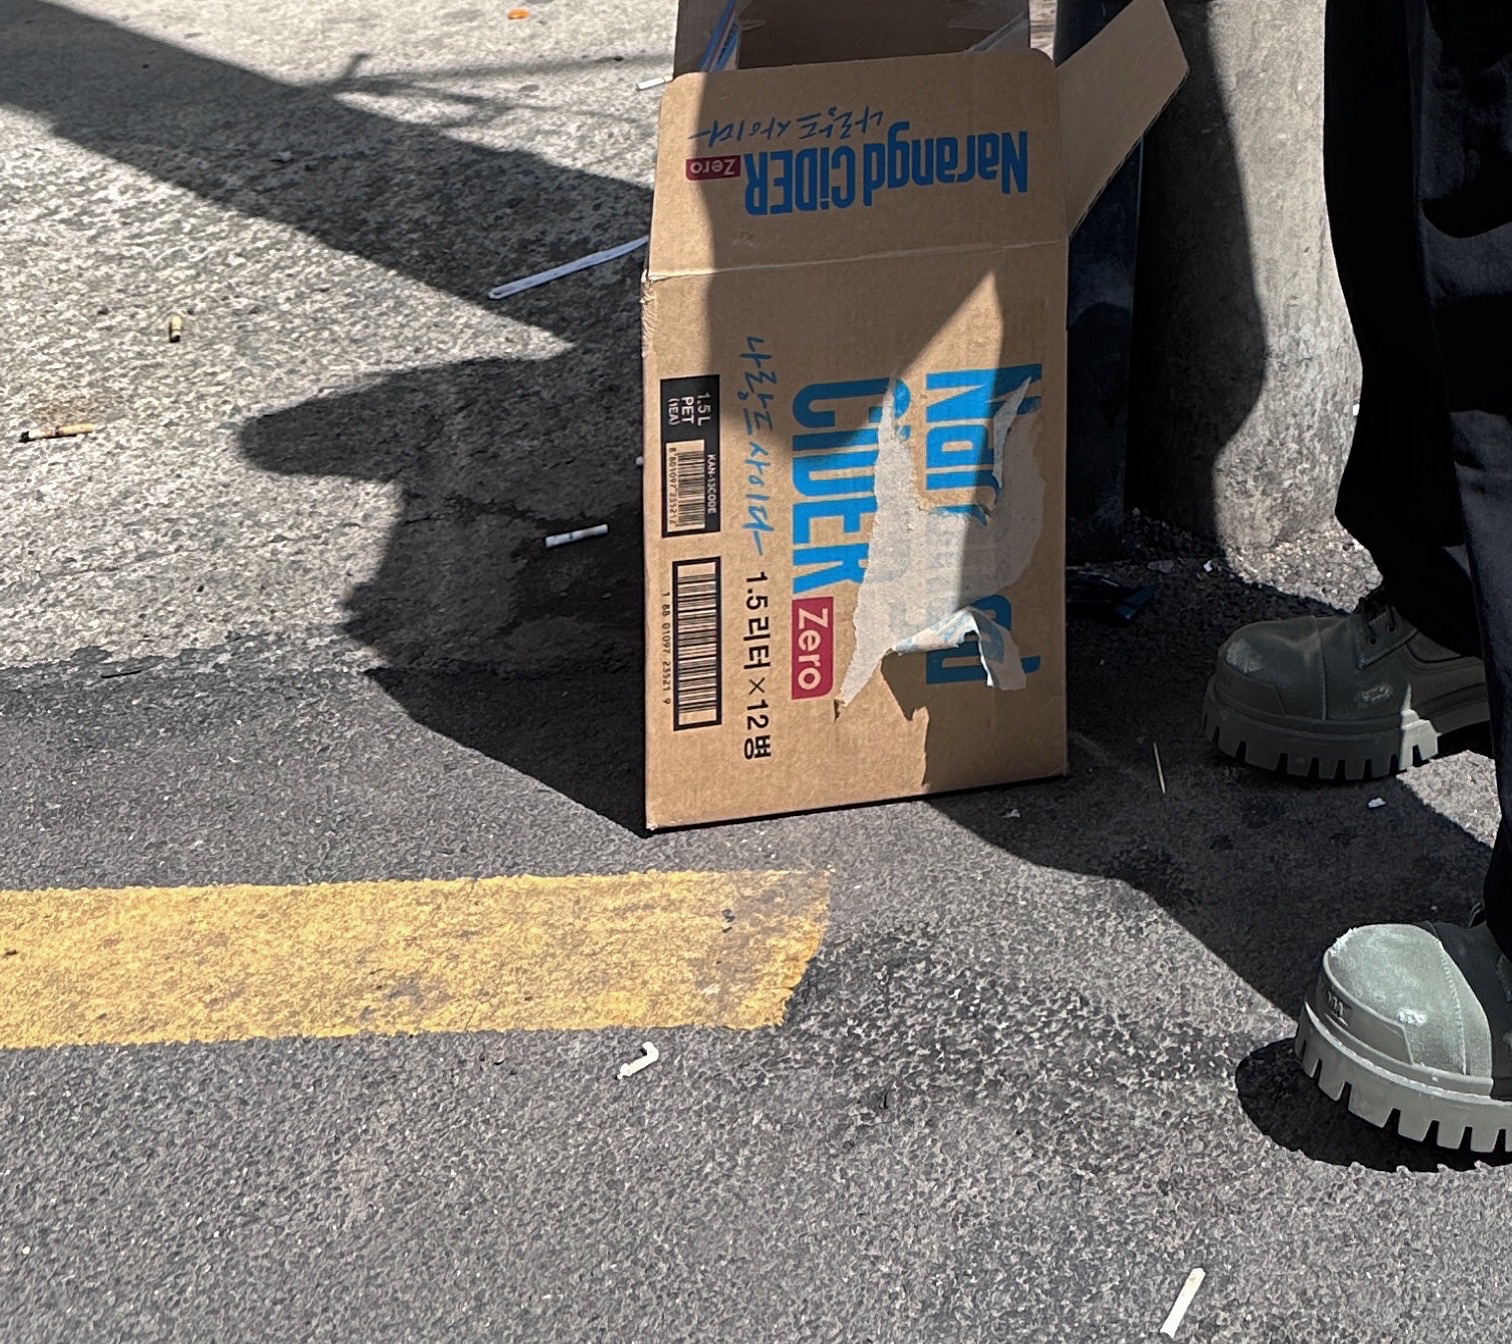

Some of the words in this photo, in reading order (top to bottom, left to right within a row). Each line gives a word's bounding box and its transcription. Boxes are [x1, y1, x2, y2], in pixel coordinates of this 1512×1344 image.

[689, 159, 736, 177] Zero
[863, 120, 1028, 207] Narangd
[668, 398, 680, 426] (1EA)
[681, 396, 694, 423] PET
[797, 607, 828, 690] Zero
